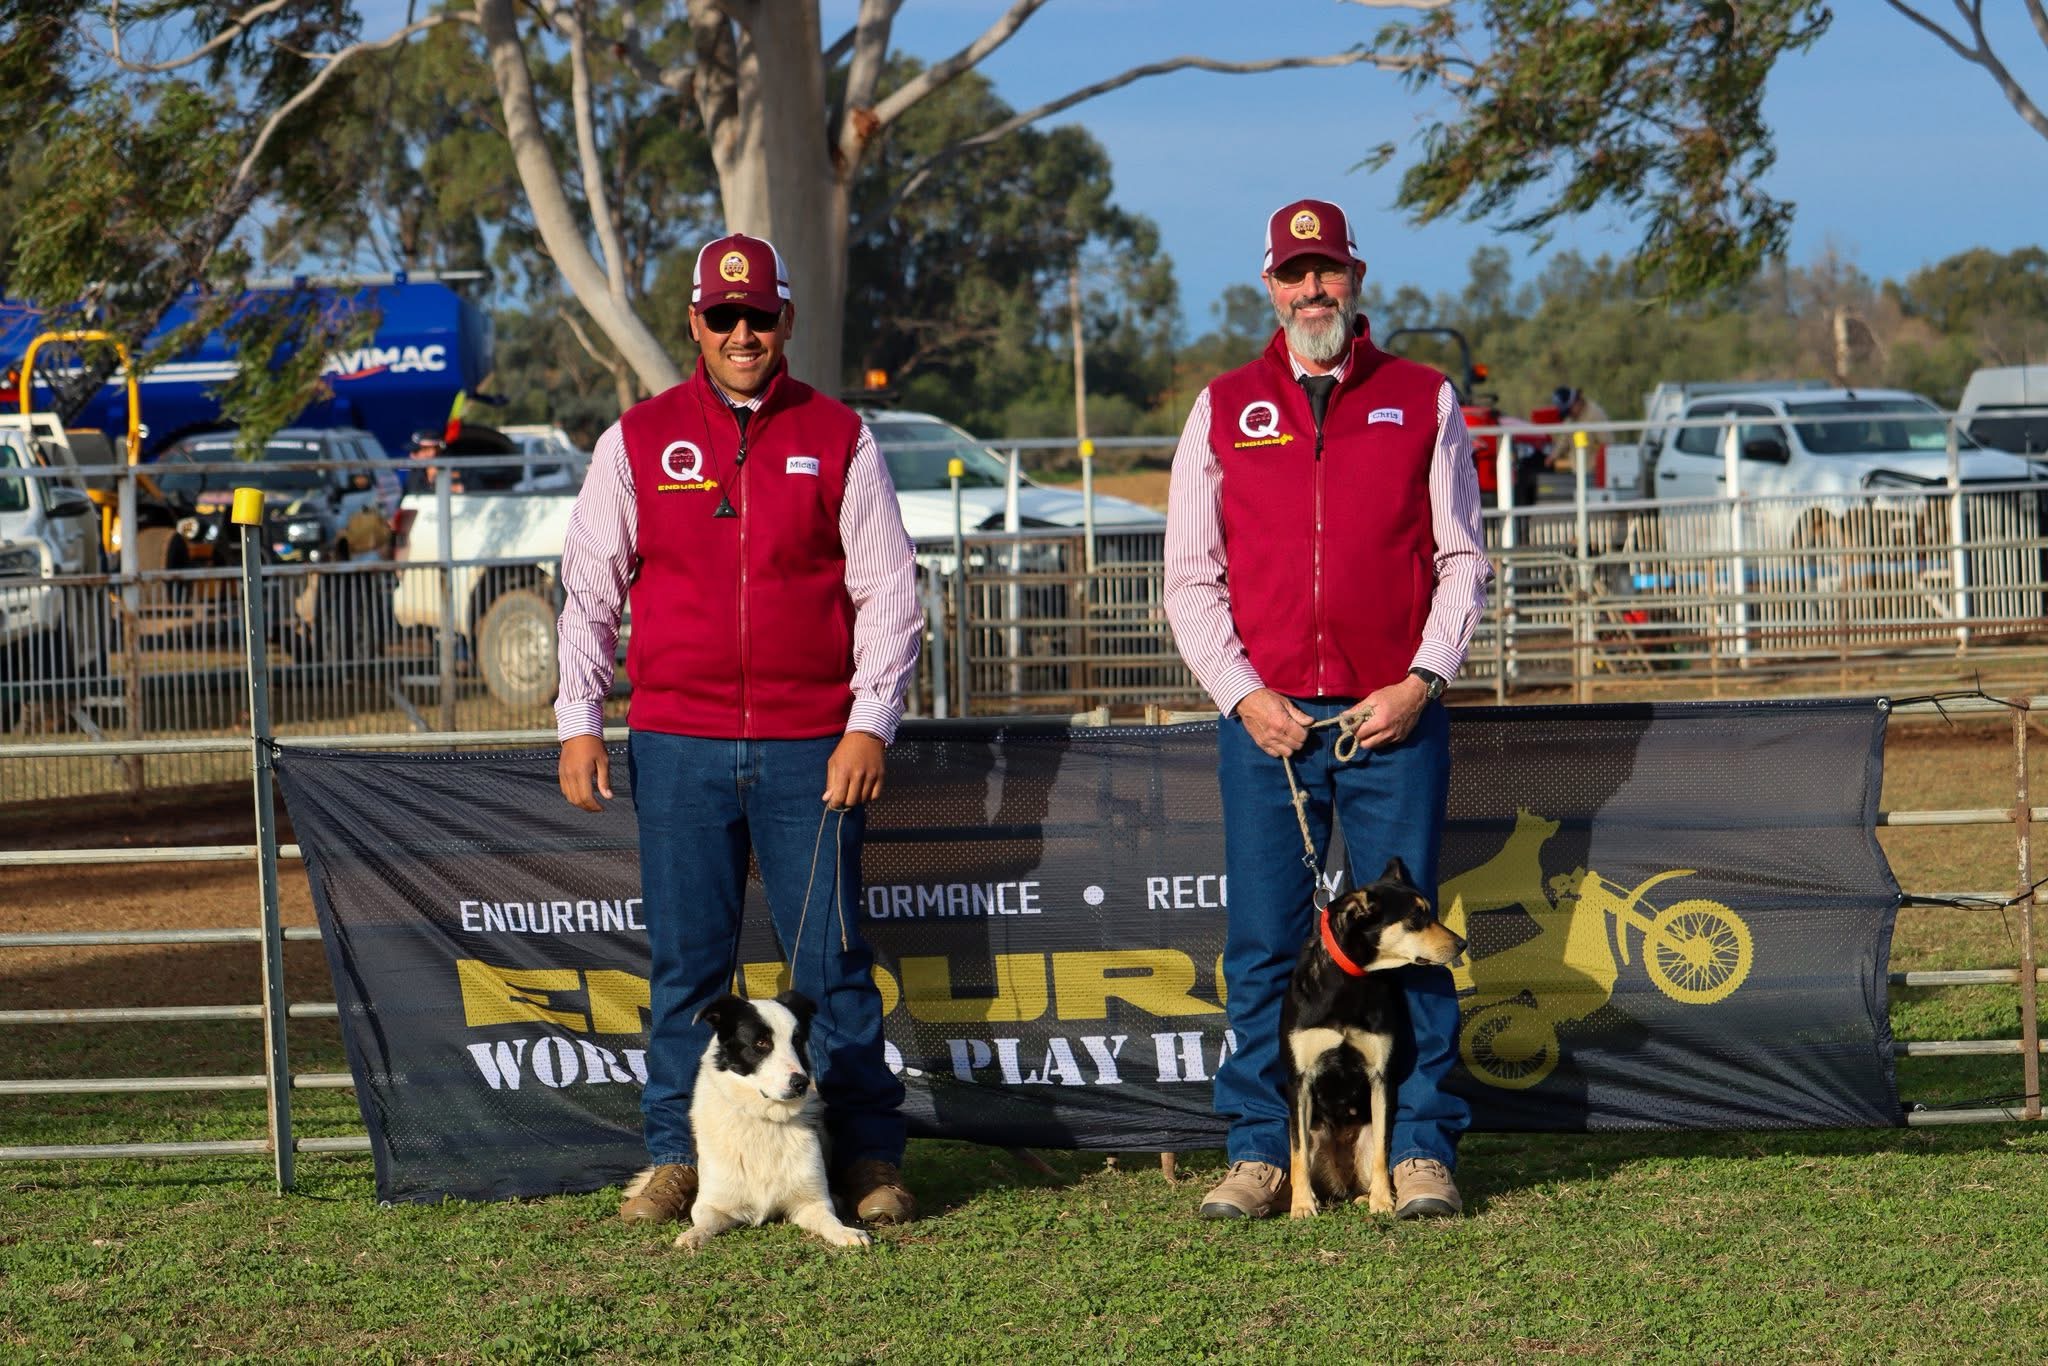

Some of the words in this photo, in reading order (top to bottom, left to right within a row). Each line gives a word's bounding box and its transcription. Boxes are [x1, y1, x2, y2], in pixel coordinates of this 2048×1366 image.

[1290, 210, 1321, 240] Q
[720, 251, 750, 283] Q
[319, 344, 447, 376] AVIMAC
[1238, 400, 1280, 438] Q
[1372, 411, 1399, 420] Chris
[661, 440, 704, 482] Q
[459, 898, 647, 934] ENDURANC
[860, 880, 1042, 919] ORMANCE
[456, 948, 1228, 1034] EUR
[946, 1034, 1128, 1086] PLAY
